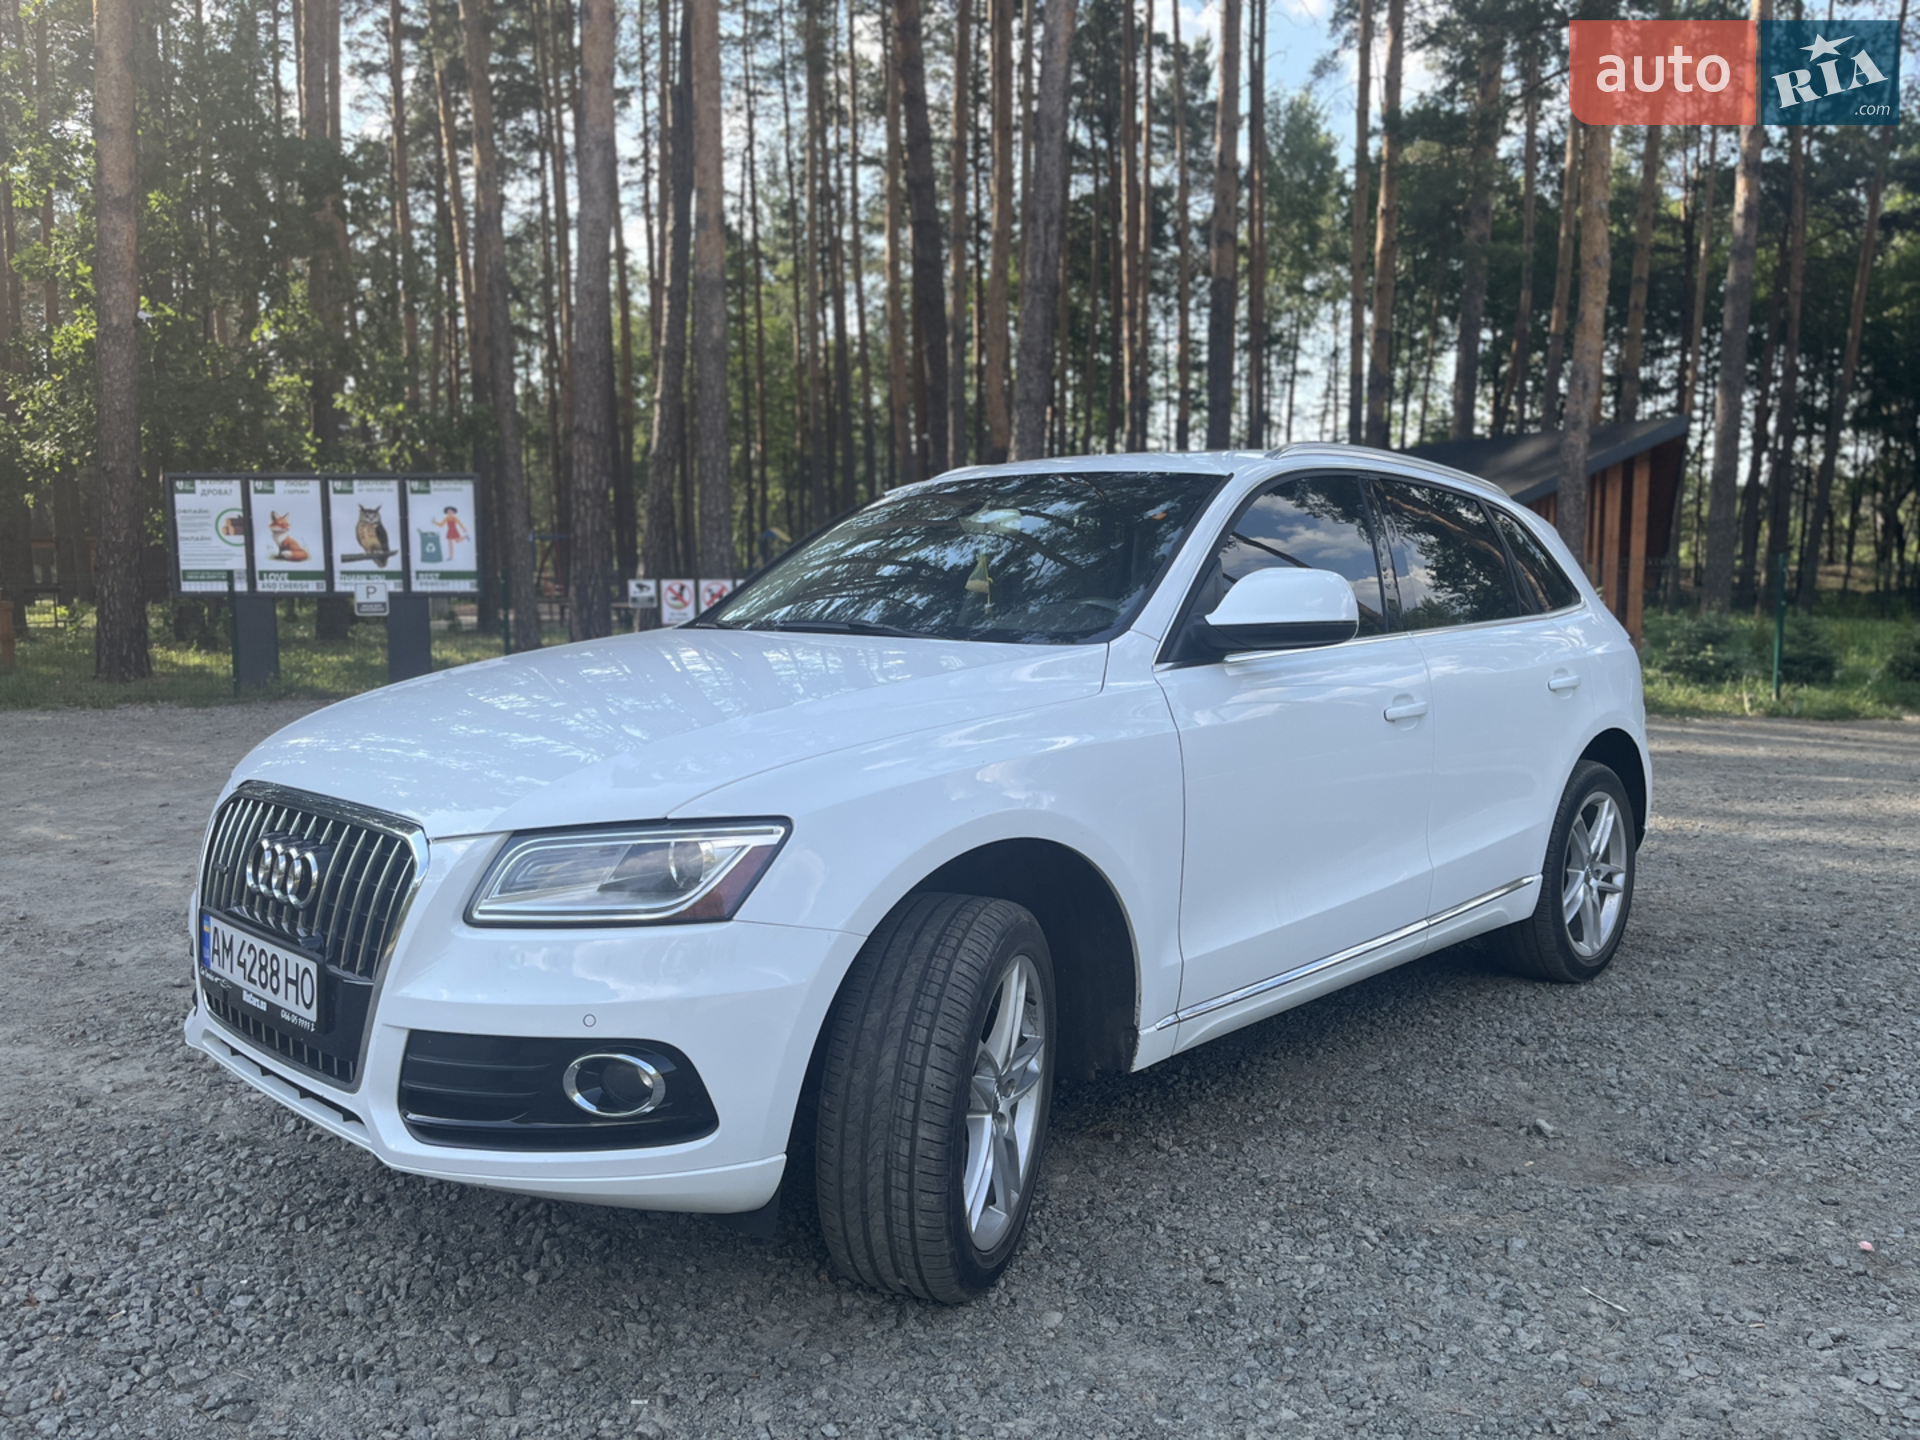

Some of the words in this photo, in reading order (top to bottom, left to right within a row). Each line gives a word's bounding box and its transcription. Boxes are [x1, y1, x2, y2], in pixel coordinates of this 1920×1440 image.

[263, 572, 289, 581] LOVE
[366, 585, 377, 599] P
[211, 926, 234, 974] AM
[237, 939, 281, 995] 4288
[284, 958, 315, 1010] HO
